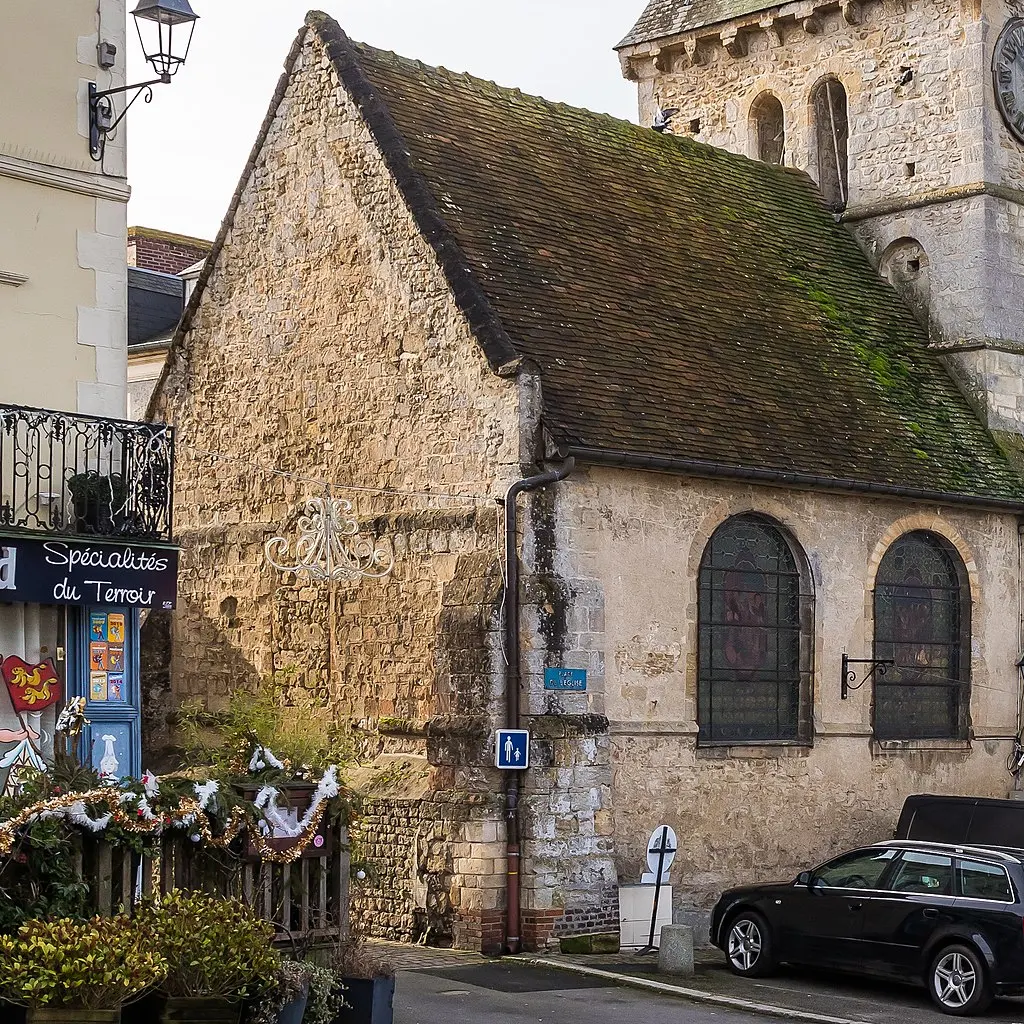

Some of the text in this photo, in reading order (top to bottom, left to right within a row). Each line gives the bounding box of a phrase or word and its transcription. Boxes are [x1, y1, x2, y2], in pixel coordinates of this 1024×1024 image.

[43, 541, 169, 572] Spécialités
[53, 577, 156, 605] du Terroir
